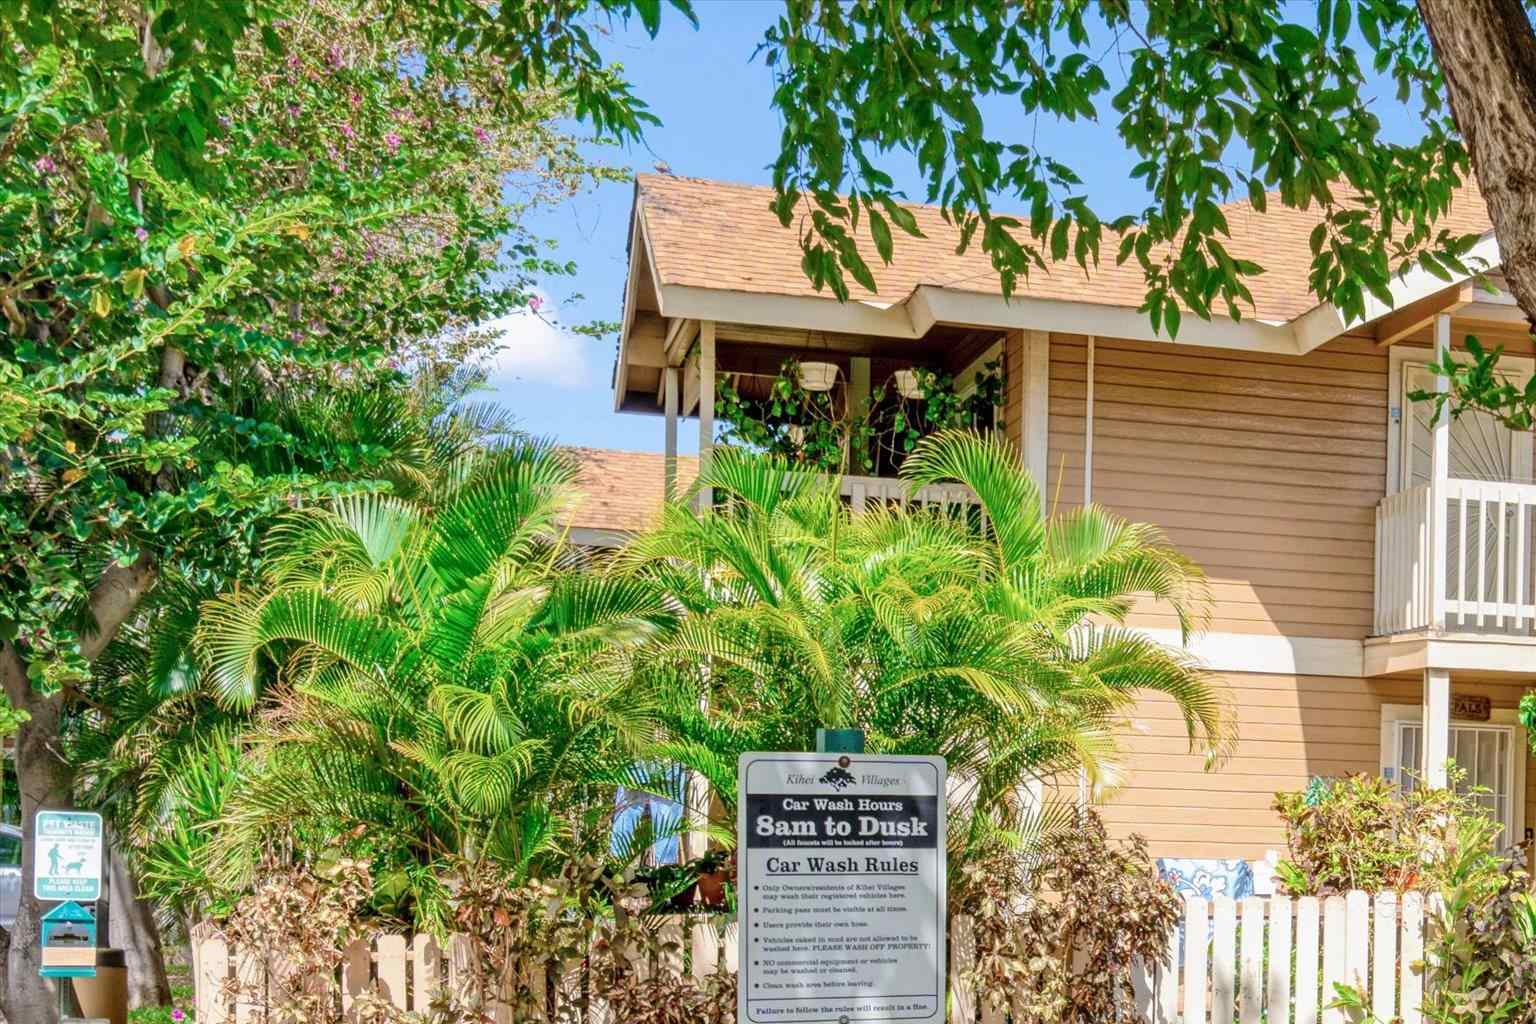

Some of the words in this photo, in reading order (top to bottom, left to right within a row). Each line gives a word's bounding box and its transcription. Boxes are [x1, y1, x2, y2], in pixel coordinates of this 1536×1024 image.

[786, 774, 815, 785] Kihei
[860, 775, 901, 788] Villages
[783, 799, 810, 811] Car
[813, 798, 855, 811] Wash
[858, 798, 904, 811] Hours
[756, 815, 817, 836] 8am
[824, 816, 851, 836] to
[858, 816, 928, 837] Dusk
[766, 858, 801, 873] Car
[807, 857, 859, 872] Wash
[865, 857, 919, 872] Rules
